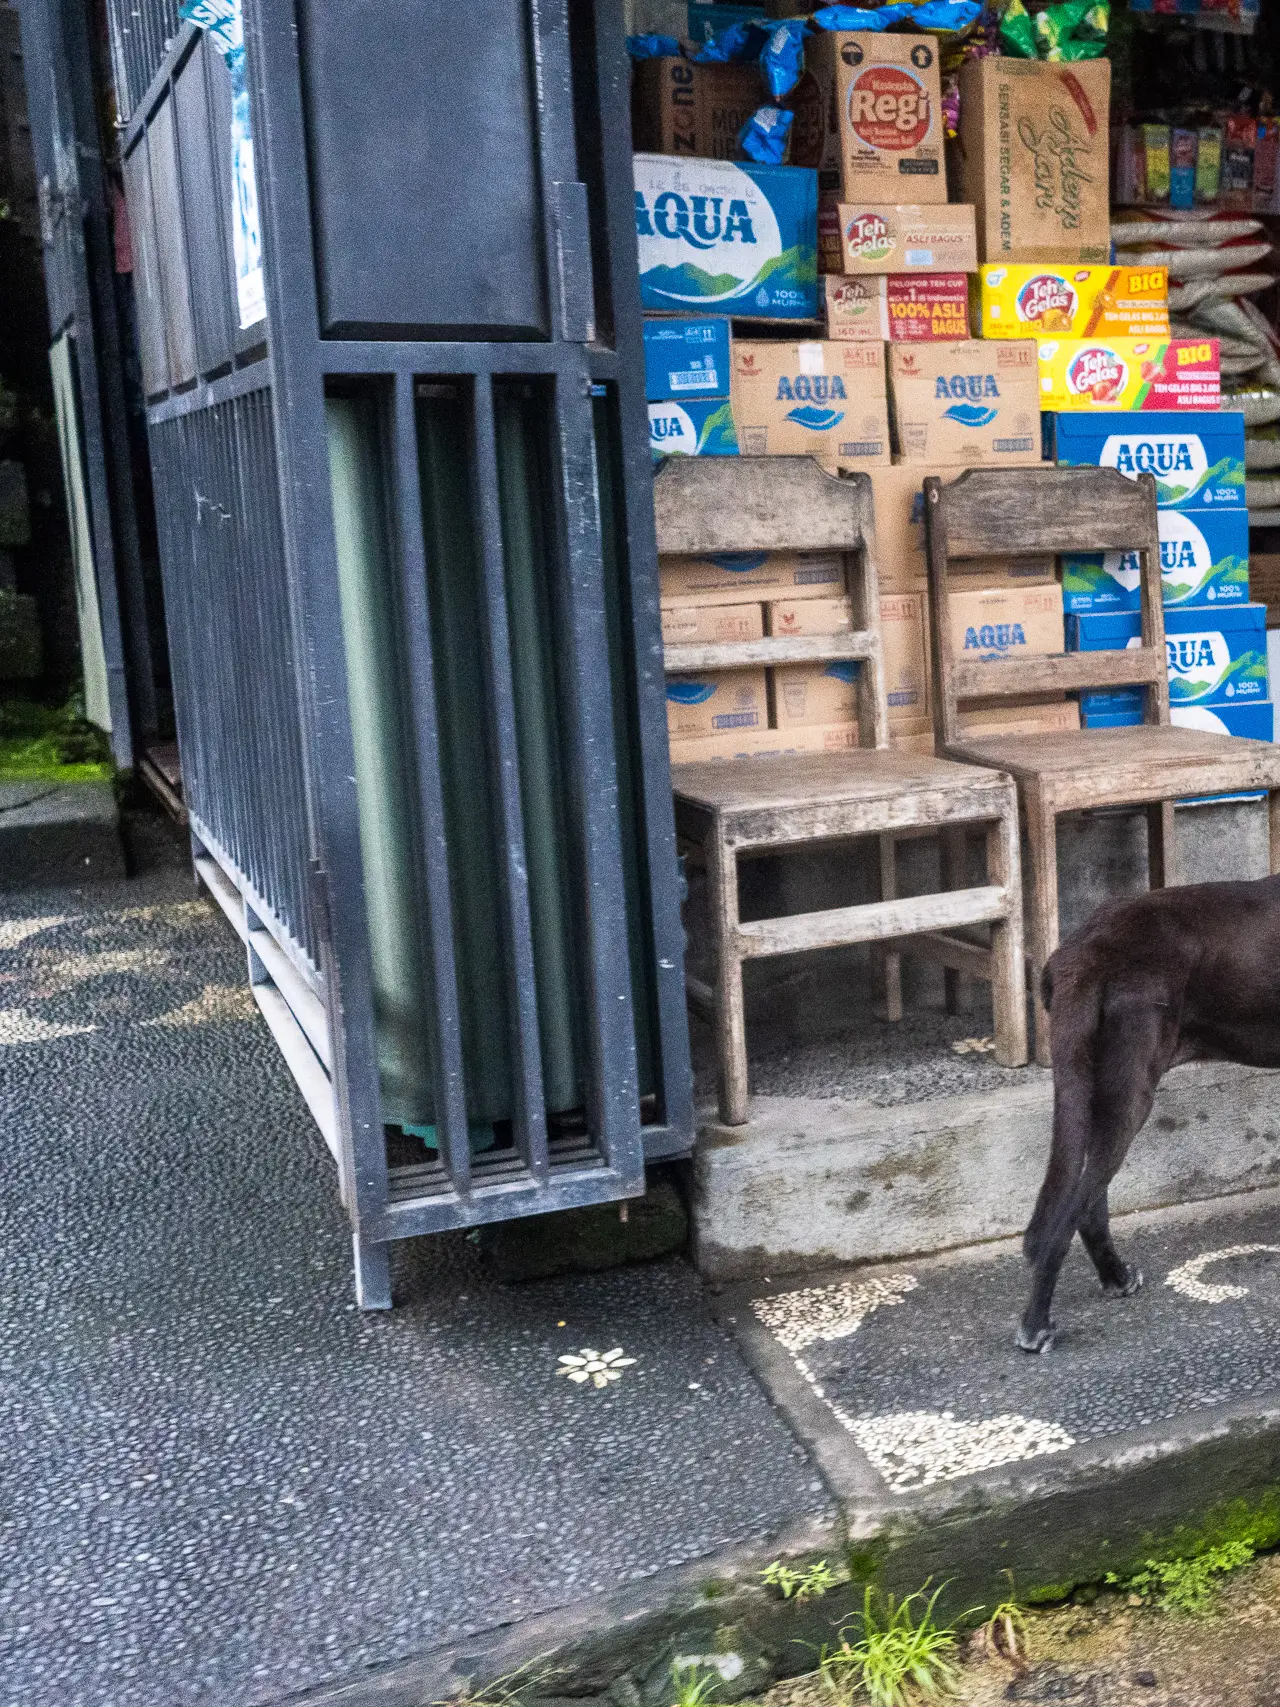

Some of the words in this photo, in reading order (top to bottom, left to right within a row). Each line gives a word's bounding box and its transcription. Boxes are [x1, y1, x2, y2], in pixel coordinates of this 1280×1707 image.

[670, 66, 696, 151] zone
[851, 87, 930, 132] Regi
[854, 218, 886, 239] Teh
[848, 236, 897, 257] Gelas
[840, 284, 865, 302] Teh
[1030, 279, 1058, 298] Teh
[1129, 272, 1164, 293] BIG
[890, 303, 931, 318] 100%
[932, 303, 965, 318] ASLI
[1025, 293, 1068, 317] Gelas
[931, 318, 967, 335] BAGUS
[1081, 352, 1108, 371] Teh
[1177, 344, 1212, 367] BIG
[776, 374, 848, 405] AQUA
[935, 374, 1000, 402] AQUA
[1076, 366, 1118, 391] Gelas
[651, 416, 685, 441] UA
[1116, 442, 1194, 477] AQUA
[963, 623, 1027, 651] AQUA
[1166, 639, 1216, 674] QUA
